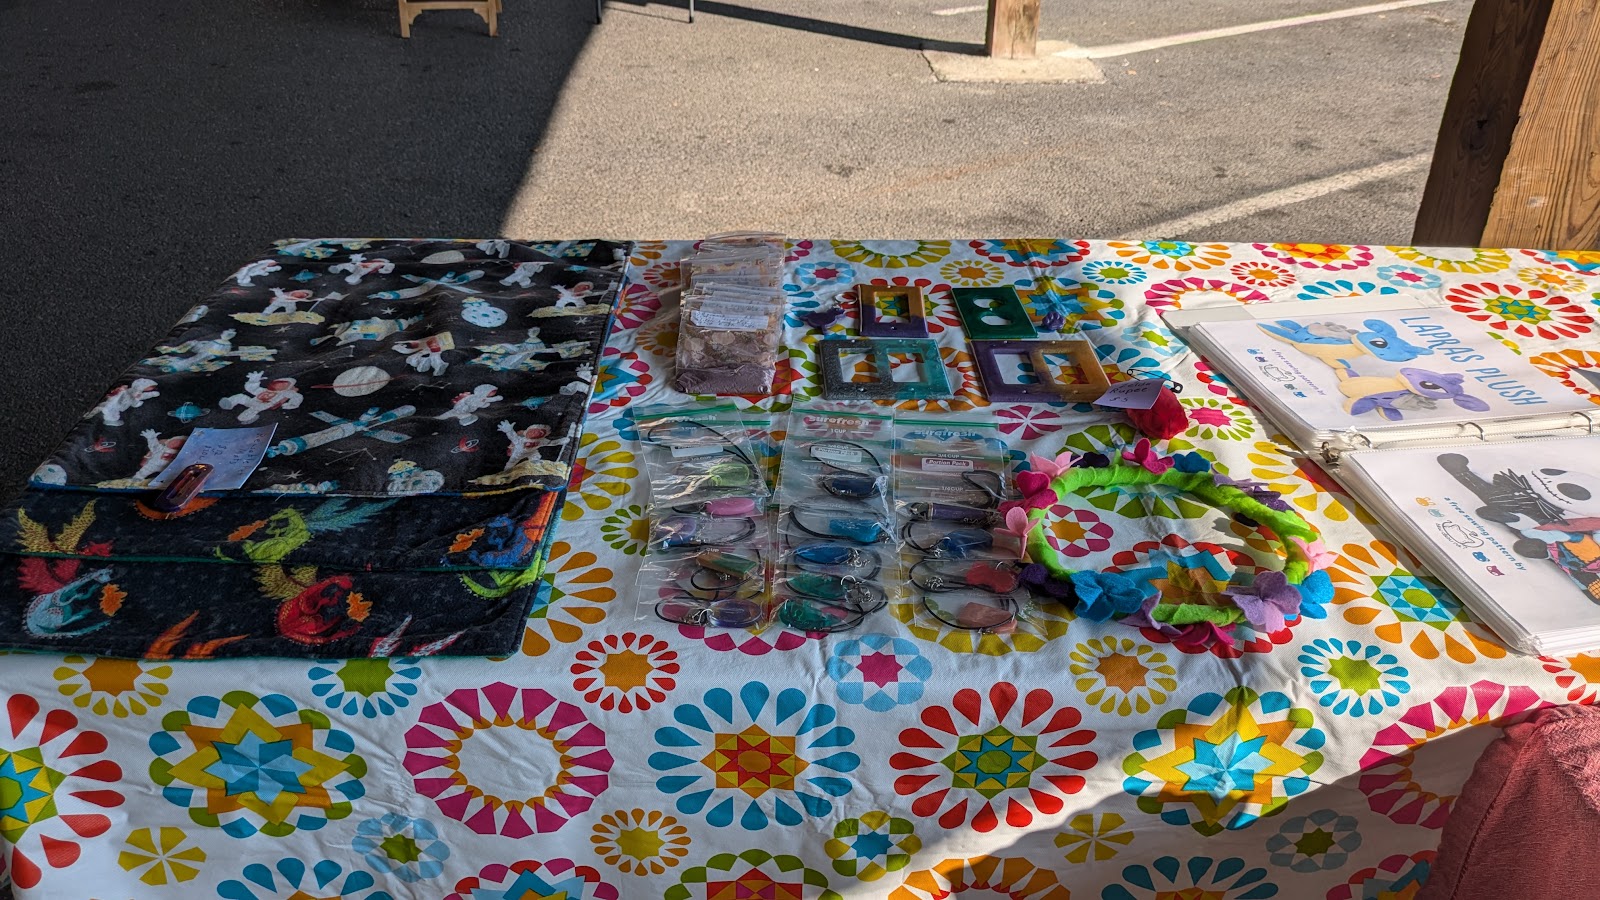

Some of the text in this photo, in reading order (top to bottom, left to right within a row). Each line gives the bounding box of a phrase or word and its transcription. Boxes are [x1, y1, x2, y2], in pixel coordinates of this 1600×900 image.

[1110, 387, 1148, 395] Rupee
[1400, 316, 1549, 406] LAPRAS PLUSH
[1449, 501, 1465, 514] free
[1463, 514, 1489, 536] sewing
[1486, 536, 1516, 562] pattern
[1514, 562, 1527, 571] by
